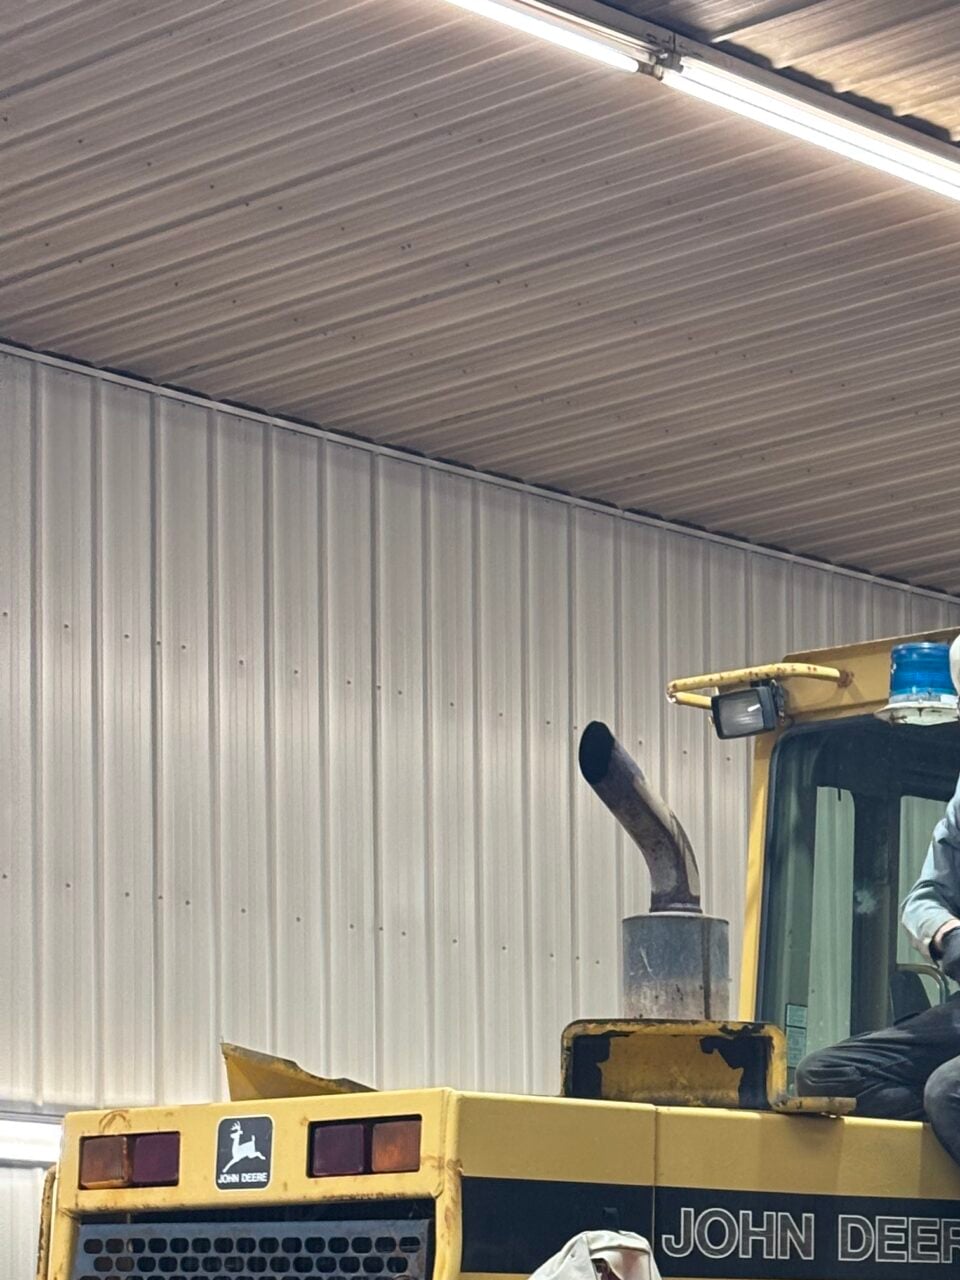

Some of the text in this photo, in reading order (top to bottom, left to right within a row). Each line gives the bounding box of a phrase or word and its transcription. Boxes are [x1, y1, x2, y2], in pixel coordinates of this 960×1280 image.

[218, 1172, 268, 1184] JOHN DEERE
[661, 1207, 815, 1260] JOHN
